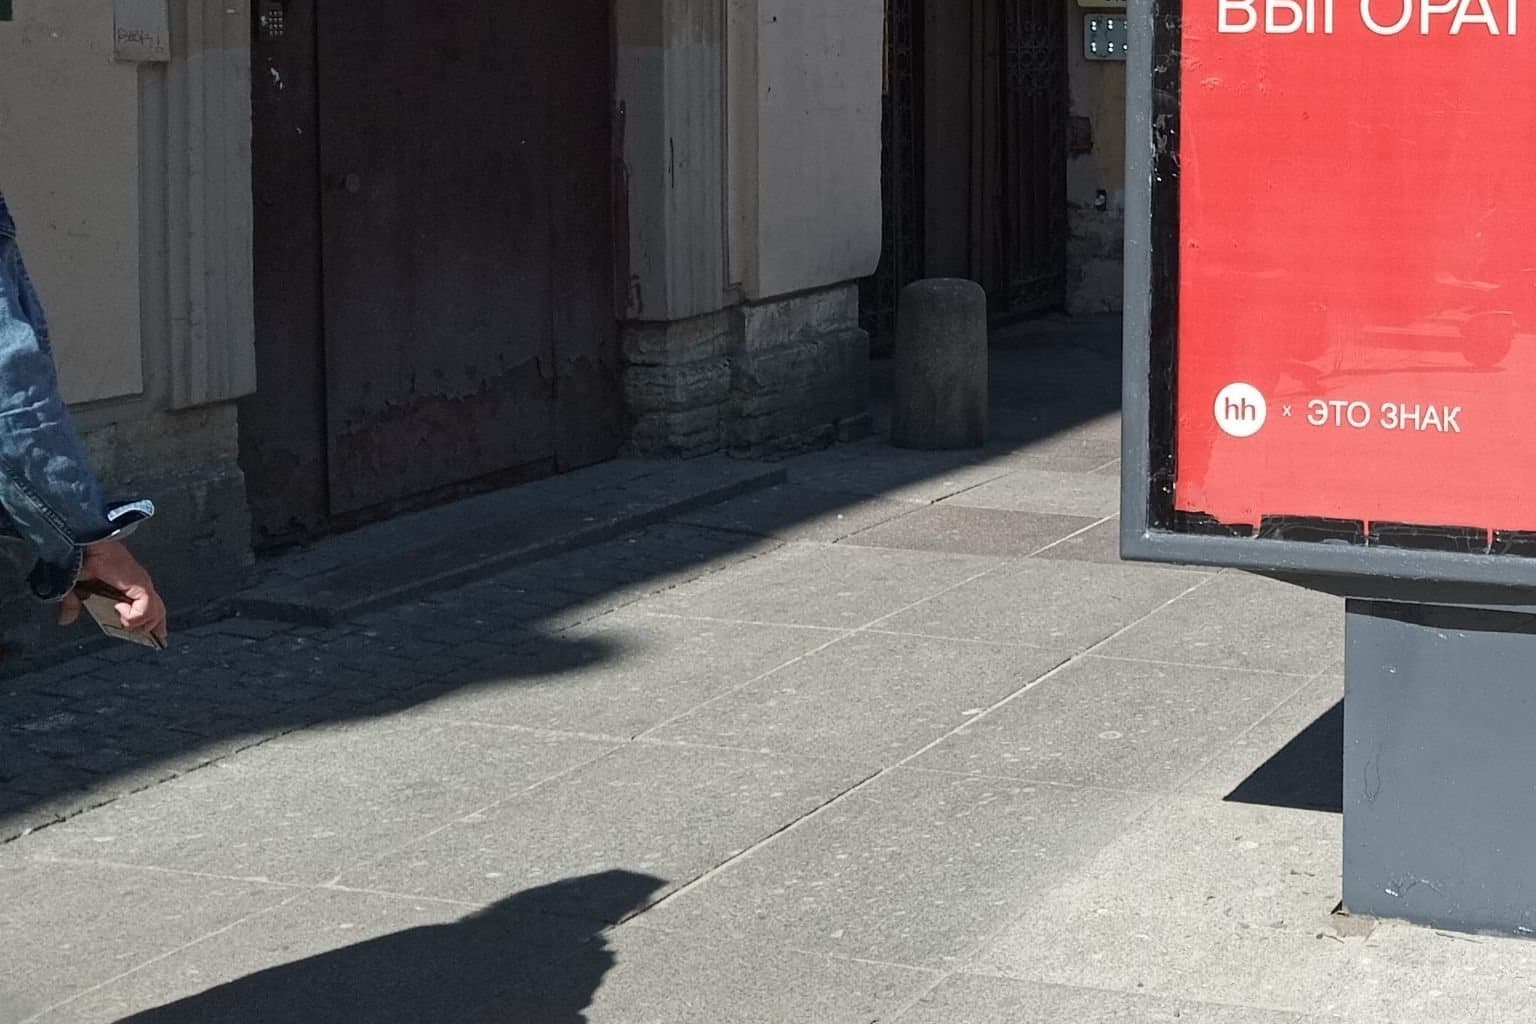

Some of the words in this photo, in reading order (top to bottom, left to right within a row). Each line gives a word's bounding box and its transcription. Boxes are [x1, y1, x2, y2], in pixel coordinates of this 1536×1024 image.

[1225, 397, 1256, 421] hh
[1306, 398, 1372, 429] ЭТО
[1379, 400, 1462, 433] ЗНАК
